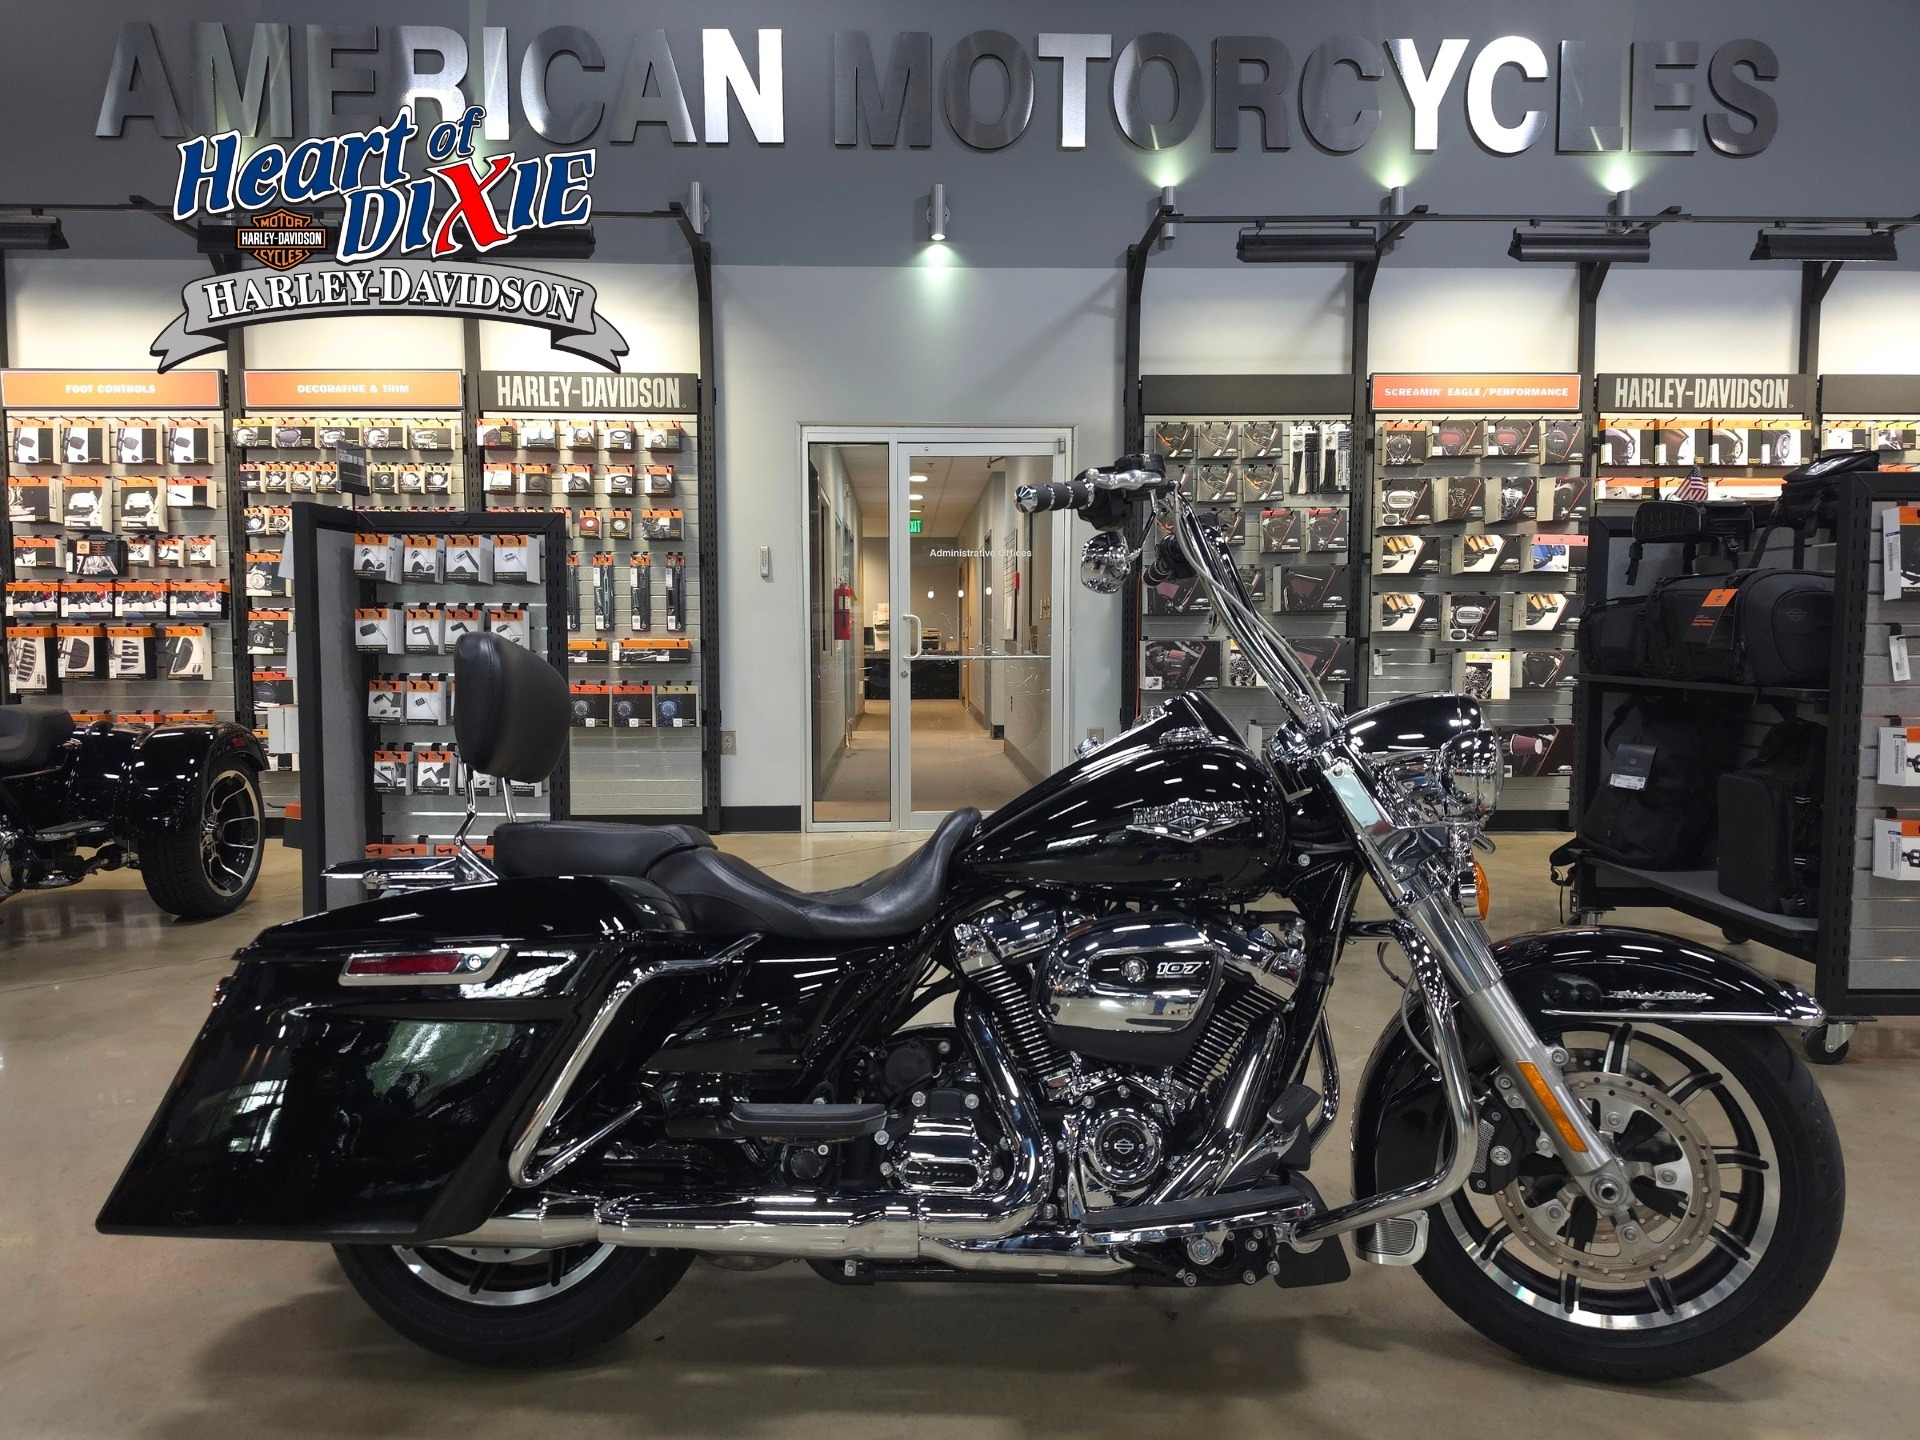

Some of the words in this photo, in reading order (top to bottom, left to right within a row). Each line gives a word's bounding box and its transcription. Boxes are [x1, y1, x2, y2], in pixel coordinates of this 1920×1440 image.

[95, 22, 784, 144] AMERICAN
[834, 28, 1780, 156] MOTORCYCLES
[65, 384, 93, 394] FOOT
[97, 384, 156, 394] CONTROLS
[297, 384, 366, 393] DECORATIVE
[370, 385, 378, 393] &
[382, 384, 409, 393] TRIM
[497, 375, 680, 409] HARLEY-DAVIDSON
[1614, 377, 1790, 409] HARLEY-DAVIDSON
[909, 520, 921, 533] XIT
[929, 548, 996, 557] Administrative
[998, 548, 1032, 557] Offices
[1156, 961, 1203, 975] 107
